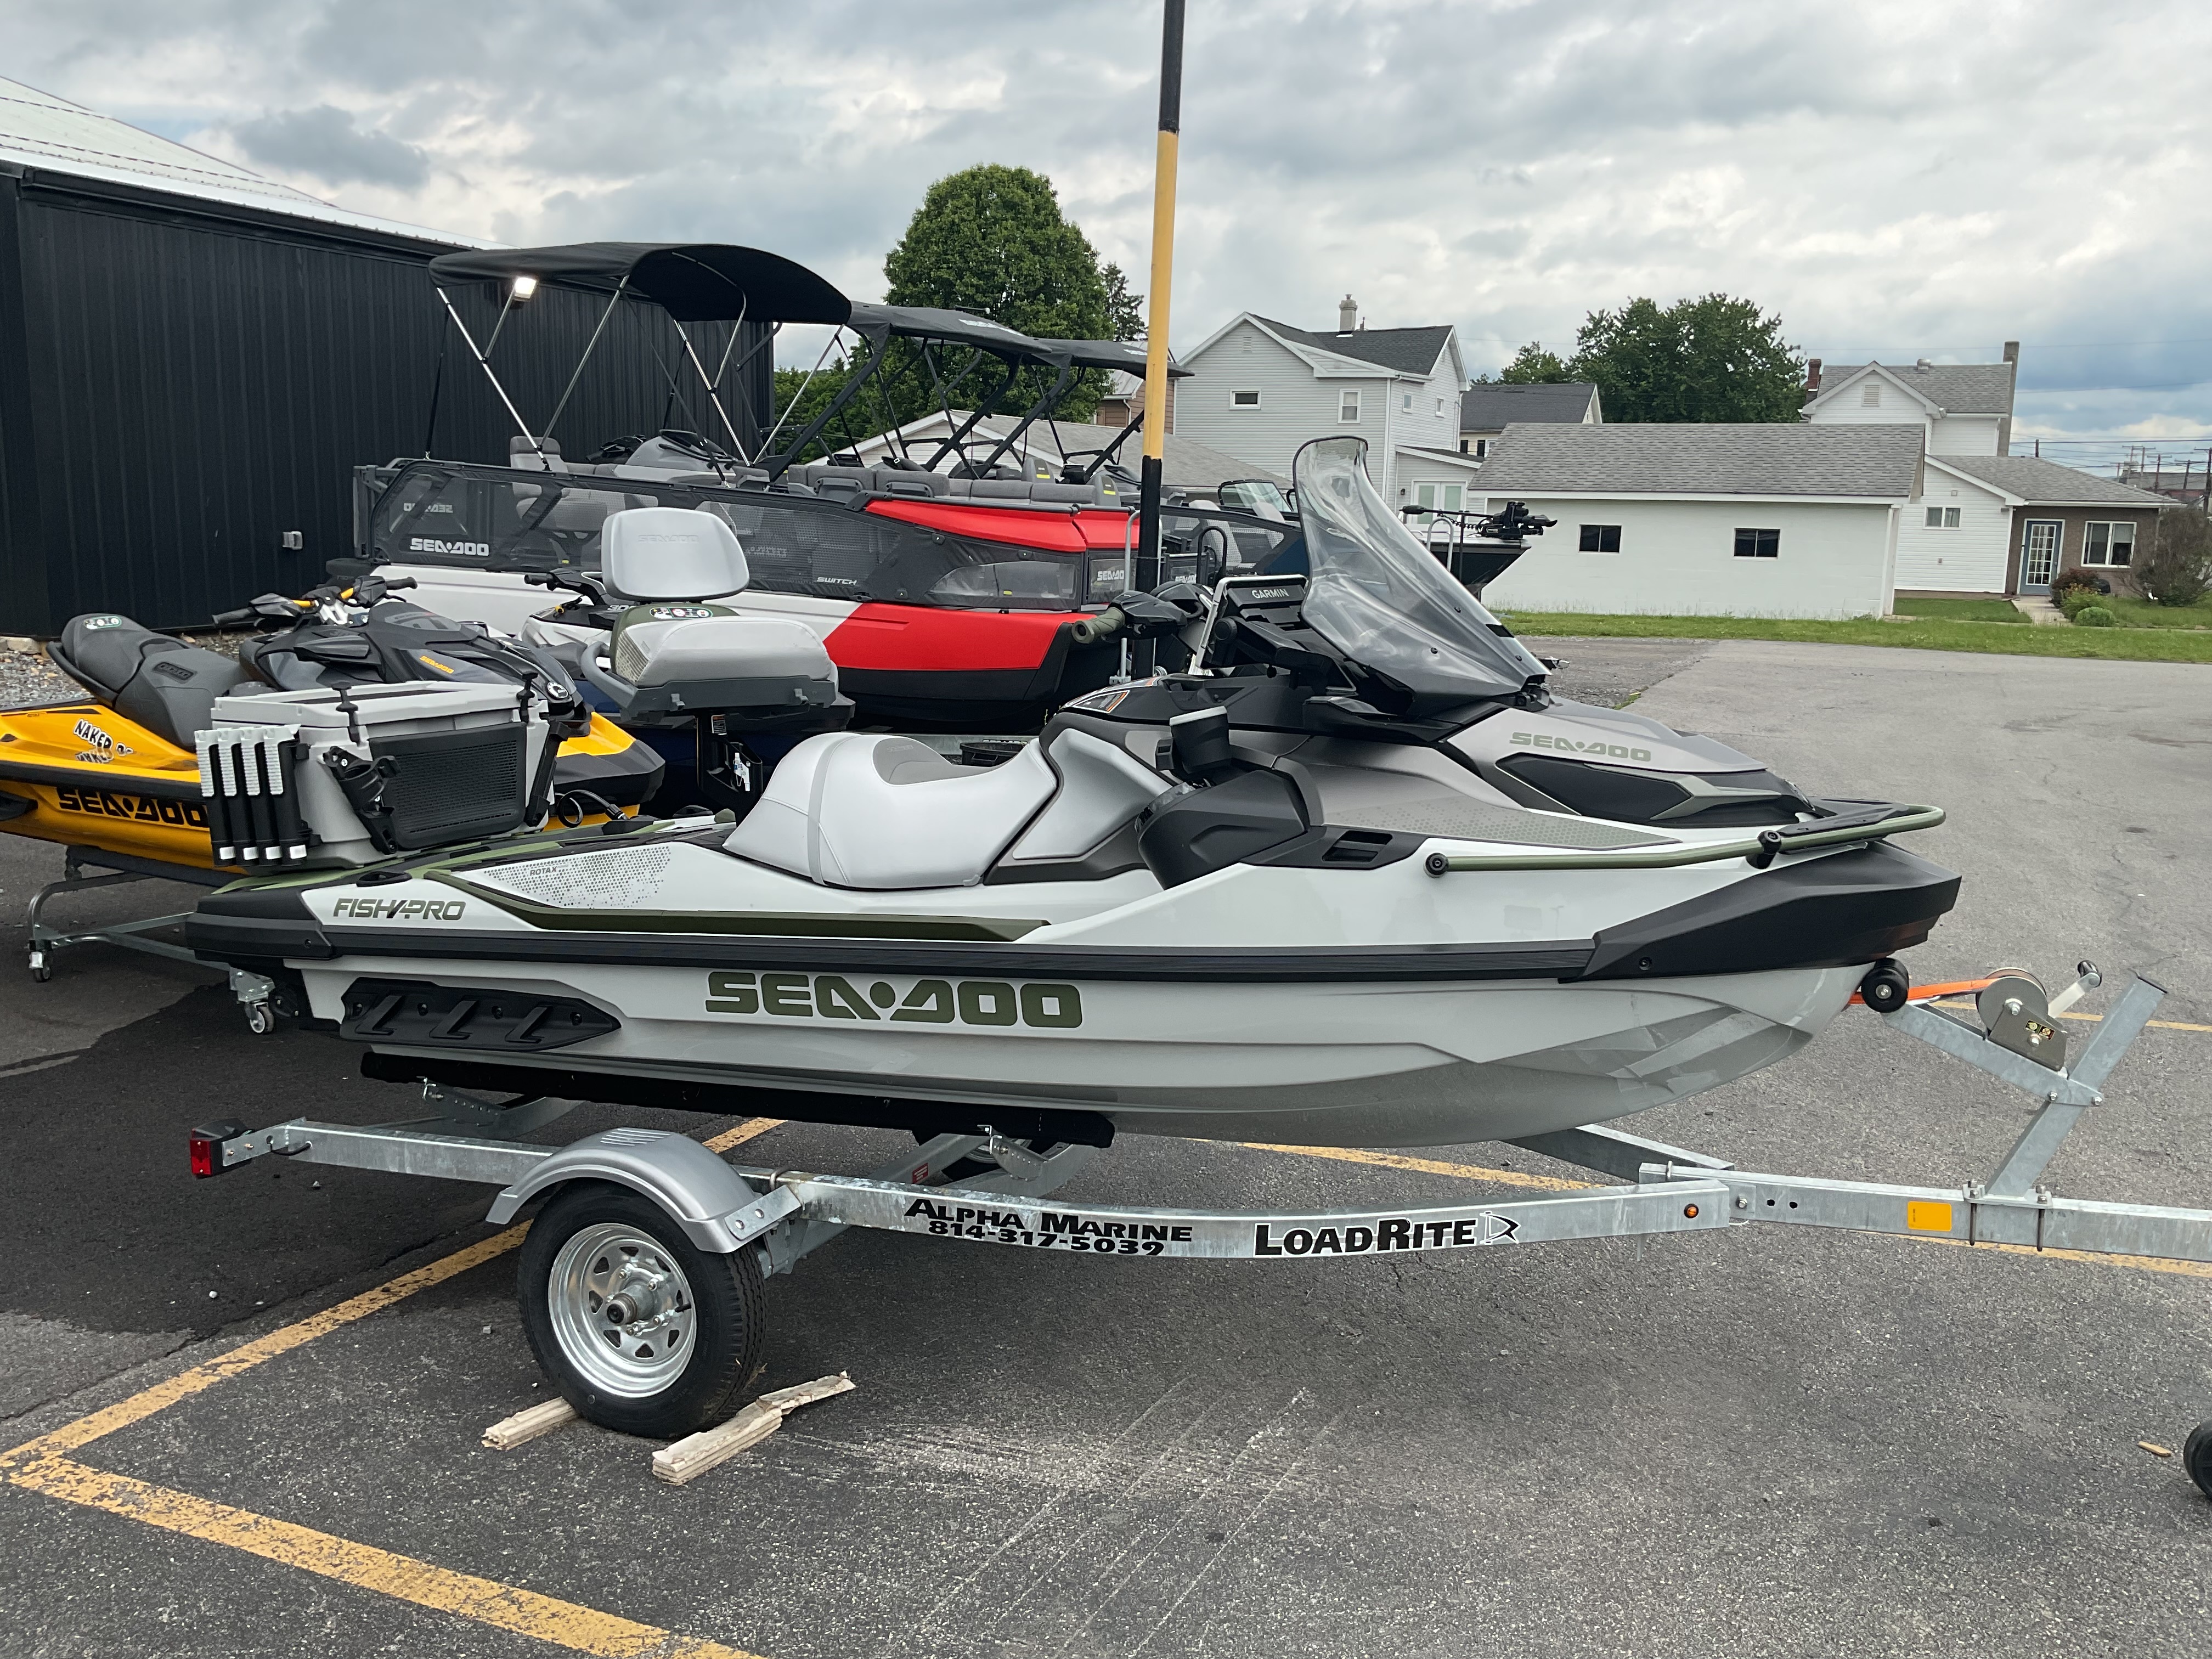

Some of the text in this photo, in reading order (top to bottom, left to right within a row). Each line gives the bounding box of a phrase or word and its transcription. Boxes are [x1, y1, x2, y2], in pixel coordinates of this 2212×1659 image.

[817, 577, 857, 585] SWITCH
[1252, 588, 1289, 599] GARMIN
[75, 719, 113, 749] NAKED
[530, 866, 557, 876] ROTAX
[904, 1198, 1193, 1242] ALPHA MARINE
[928, 1220, 1165, 1256] 814-317-5039
[1255, 1217, 1477, 1256] LOADRITE
